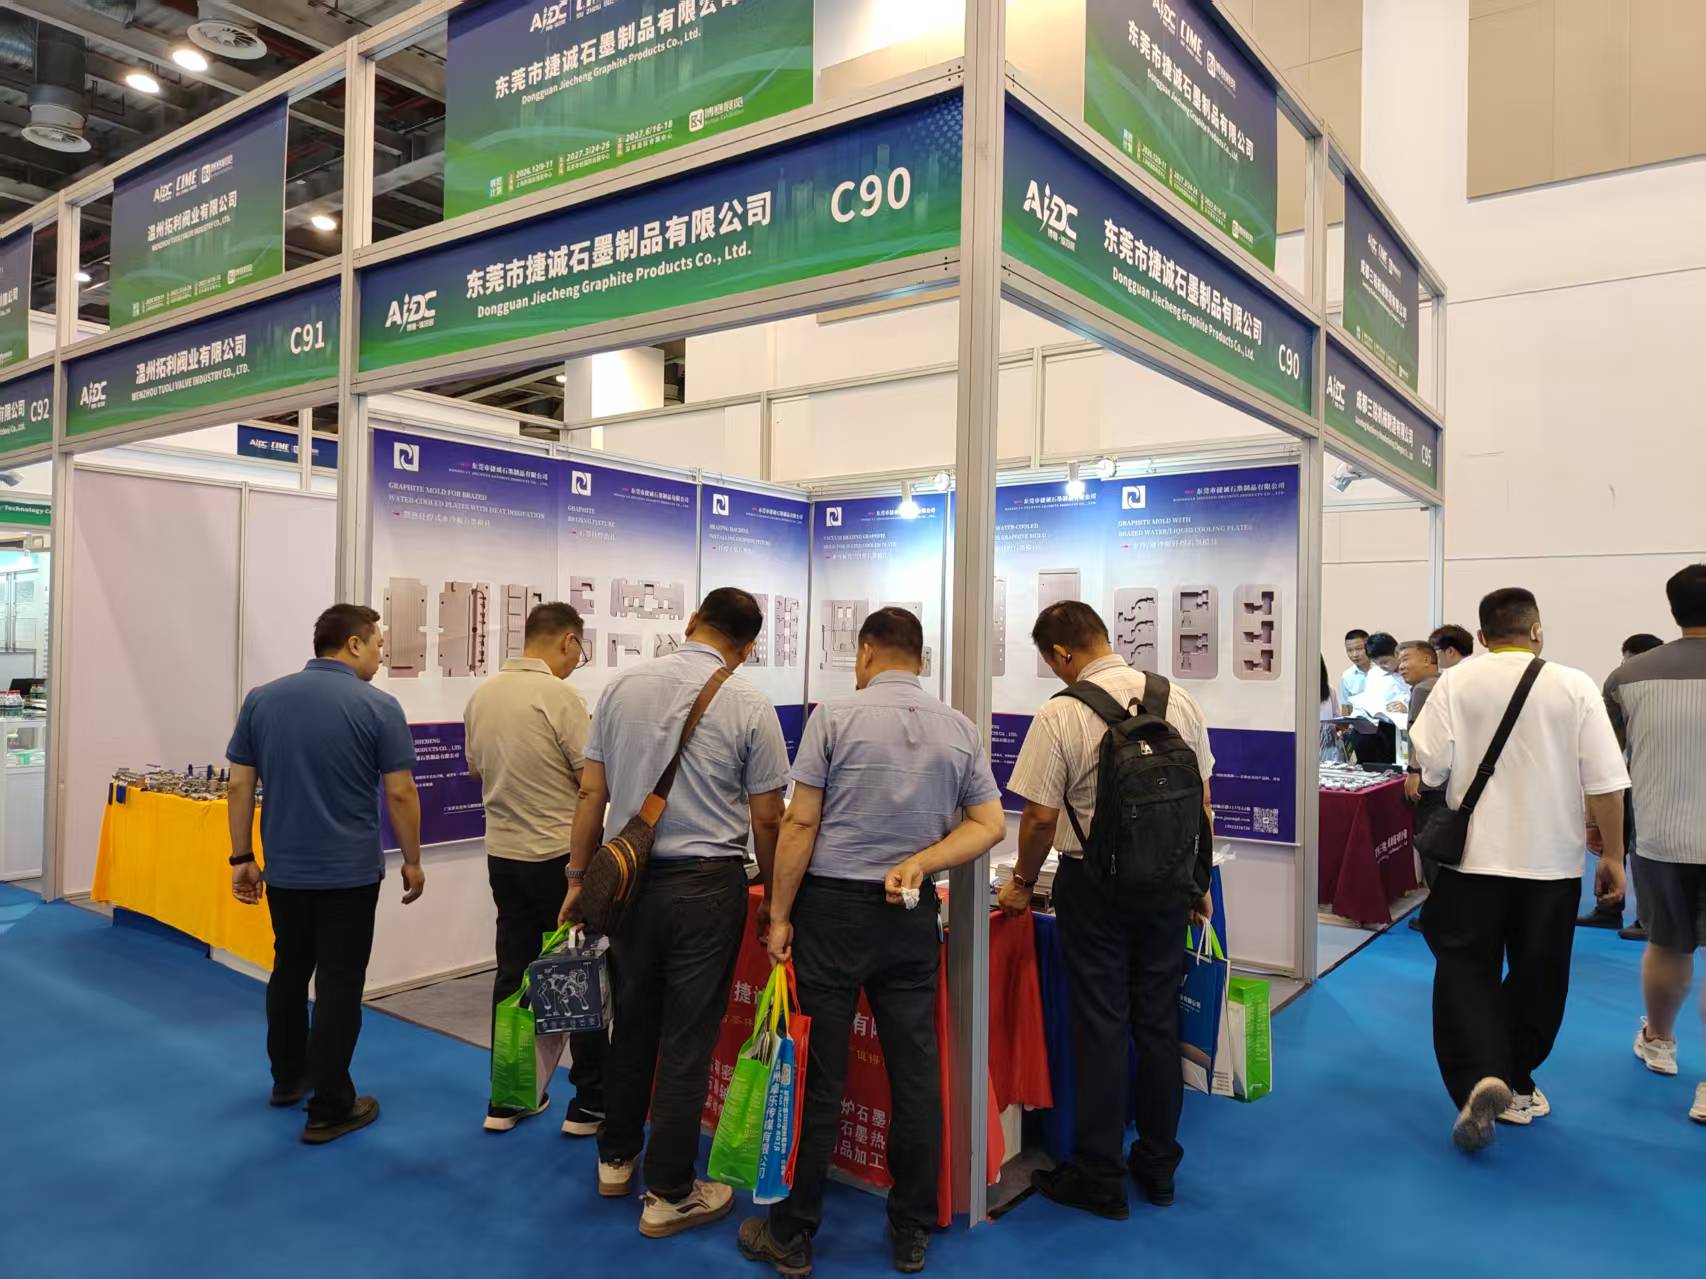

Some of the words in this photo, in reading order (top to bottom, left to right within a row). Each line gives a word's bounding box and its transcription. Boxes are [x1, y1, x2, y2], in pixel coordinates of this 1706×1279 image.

[521, 85, 558, 104] Dongguan
[558, 71, 592, 91] Jiecheng
[593, 58, 627, 77] Graphite
[628, 43, 666, 64] Products
[666, 37, 684, 50] Co.,
[685, 27, 701, 41] Ltd.
[1128, 19, 1254, 161] 东莞市捷诚石墨制品有限公司
[830, 166, 911, 224] C90
[147, 190, 238, 242] 温州拓利阀业有限公司
[466, 190, 772, 299] 东莞市捷诚石墨制品有限公司
[477, 296, 529, 318] Dongguan
[530, 284, 580, 310] Jiecheng
[582, 268, 634, 295] Graphite
[636, 256, 693, 282] Products
[695, 252, 722, 267] Co.,
[724, 241, 752, 260] Ltd.
[1104, 218, 1263, 346] 东莞市捷诚石墨制品有限公司
[1112, 266, 1150, 299] Dongguan
[1150, 289, 1182, 321] Jiecheng
[1182, 308, 1208, 335] Graphite
[1208, 324, 1234, 348] Products
[1244, 348, 1255, 361] Ltd.
[289, 320, 325, 355] C91
[135, 333, 247, 385] 温州拓利阀业有限公司
[1278, 343, 1300, 380] C90
[131, 386, 159, 402] WENZHOU
[175, 377, 194, 391] VALVE
[193, 370, 224, 387] INDUSTRY
[236, 363, 251, 375] LTD.
[30, 397, 50, 423] C92
[1421, 444, 1432, 468] C95
[388, 481, 425, 494] GRAPHITE
[425, 486, 447, 496] MOLD
[447, 489, 461, 498] FOR
[462, 491, 488, 501] BRAZED
[4, 505, 44, 515] Technology
[567, 504, 596, 515] GRAPHITE
[1117, 518, 1151, 527] GRAPHITE
[1151, 517, 1171, 526] MOLD
[1172, 516, 1192, 524] WITH
[1144, 527, 1194, 536] WATER/LIQUID
[1194, 525, 1226, 533] COOLING
[733, 980, 759, 1005] 捷
[840, 1096, 891, 1128] 炉石墨
[840, 1119, 886, 1150] 石墨热
[833, 1139, 885, 1170] 品加工
